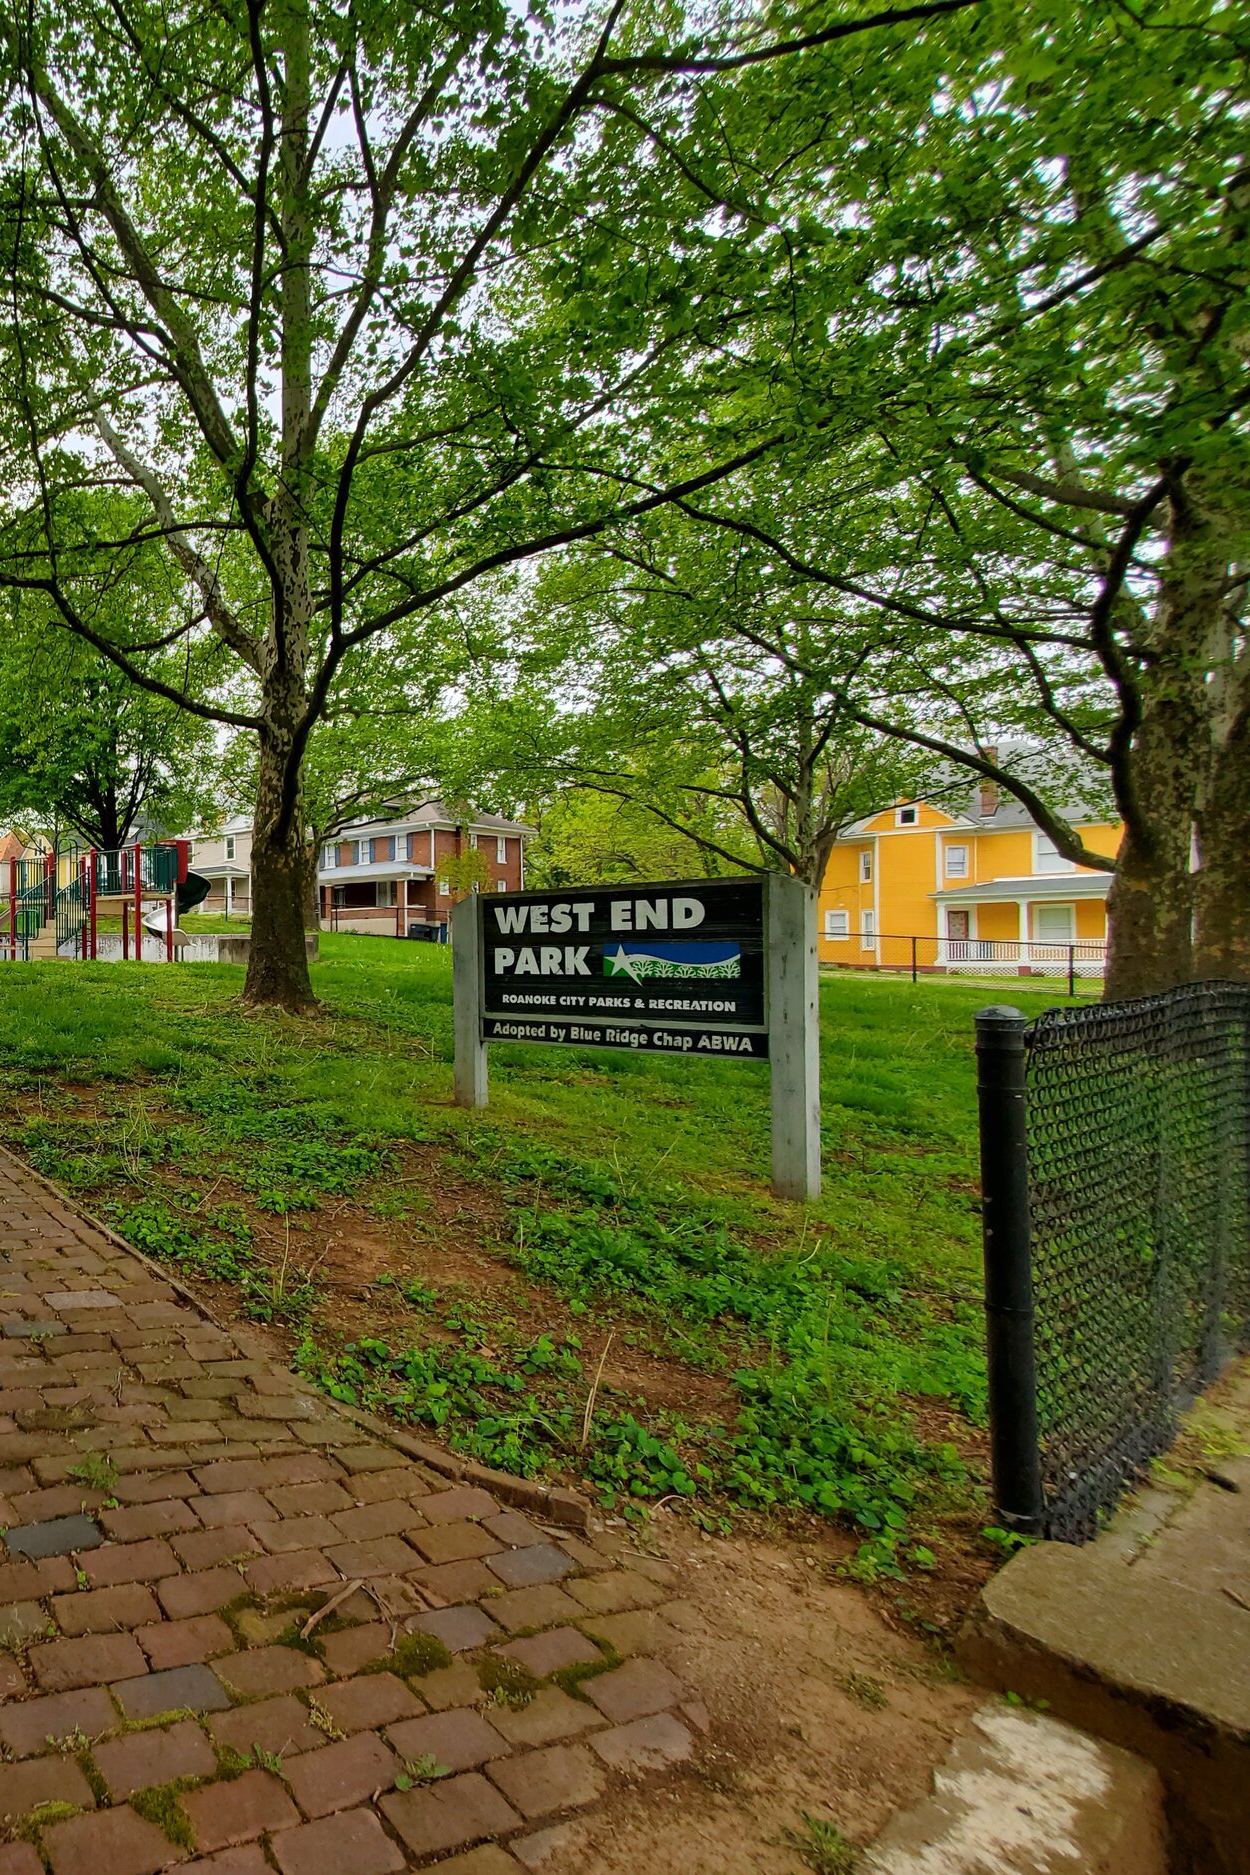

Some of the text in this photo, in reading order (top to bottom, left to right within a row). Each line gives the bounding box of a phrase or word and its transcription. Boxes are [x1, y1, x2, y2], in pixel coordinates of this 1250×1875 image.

[494, 898, 706, 934] WEST END
[494, 946, 592, 975] PARK
[502, 994, 736, 1012] ROANOKE CITY PARKS & RECREATION
[493, 1022, 753, 1052] Adopted by Blue Ridge Chap ABWA
